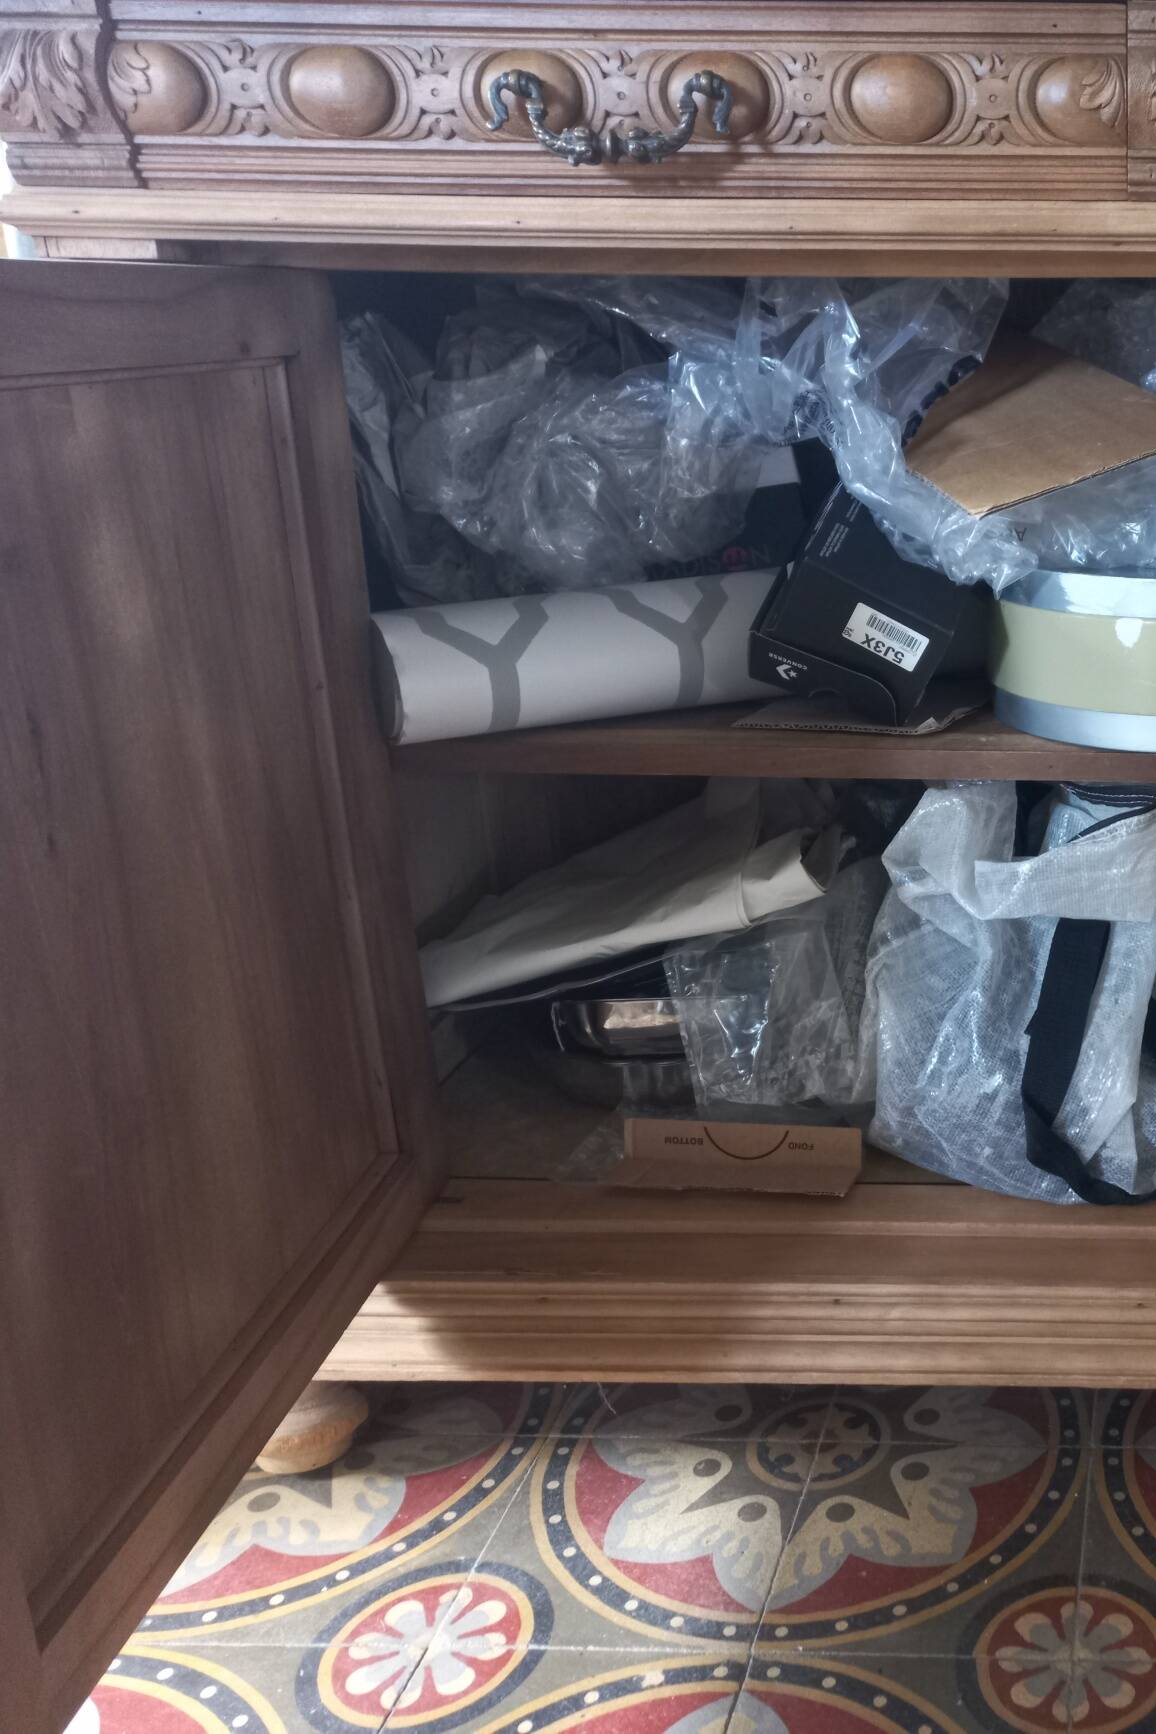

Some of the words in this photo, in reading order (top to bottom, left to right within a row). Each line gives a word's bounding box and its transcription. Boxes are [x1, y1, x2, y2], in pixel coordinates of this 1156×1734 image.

[860, 633, 905, 664] 5J3X
[767, 651, 808, 672] CONVERSE
[664, 1136, 704, 1146] BOTTOM
[787, 1141, 815, 1151] FOND
